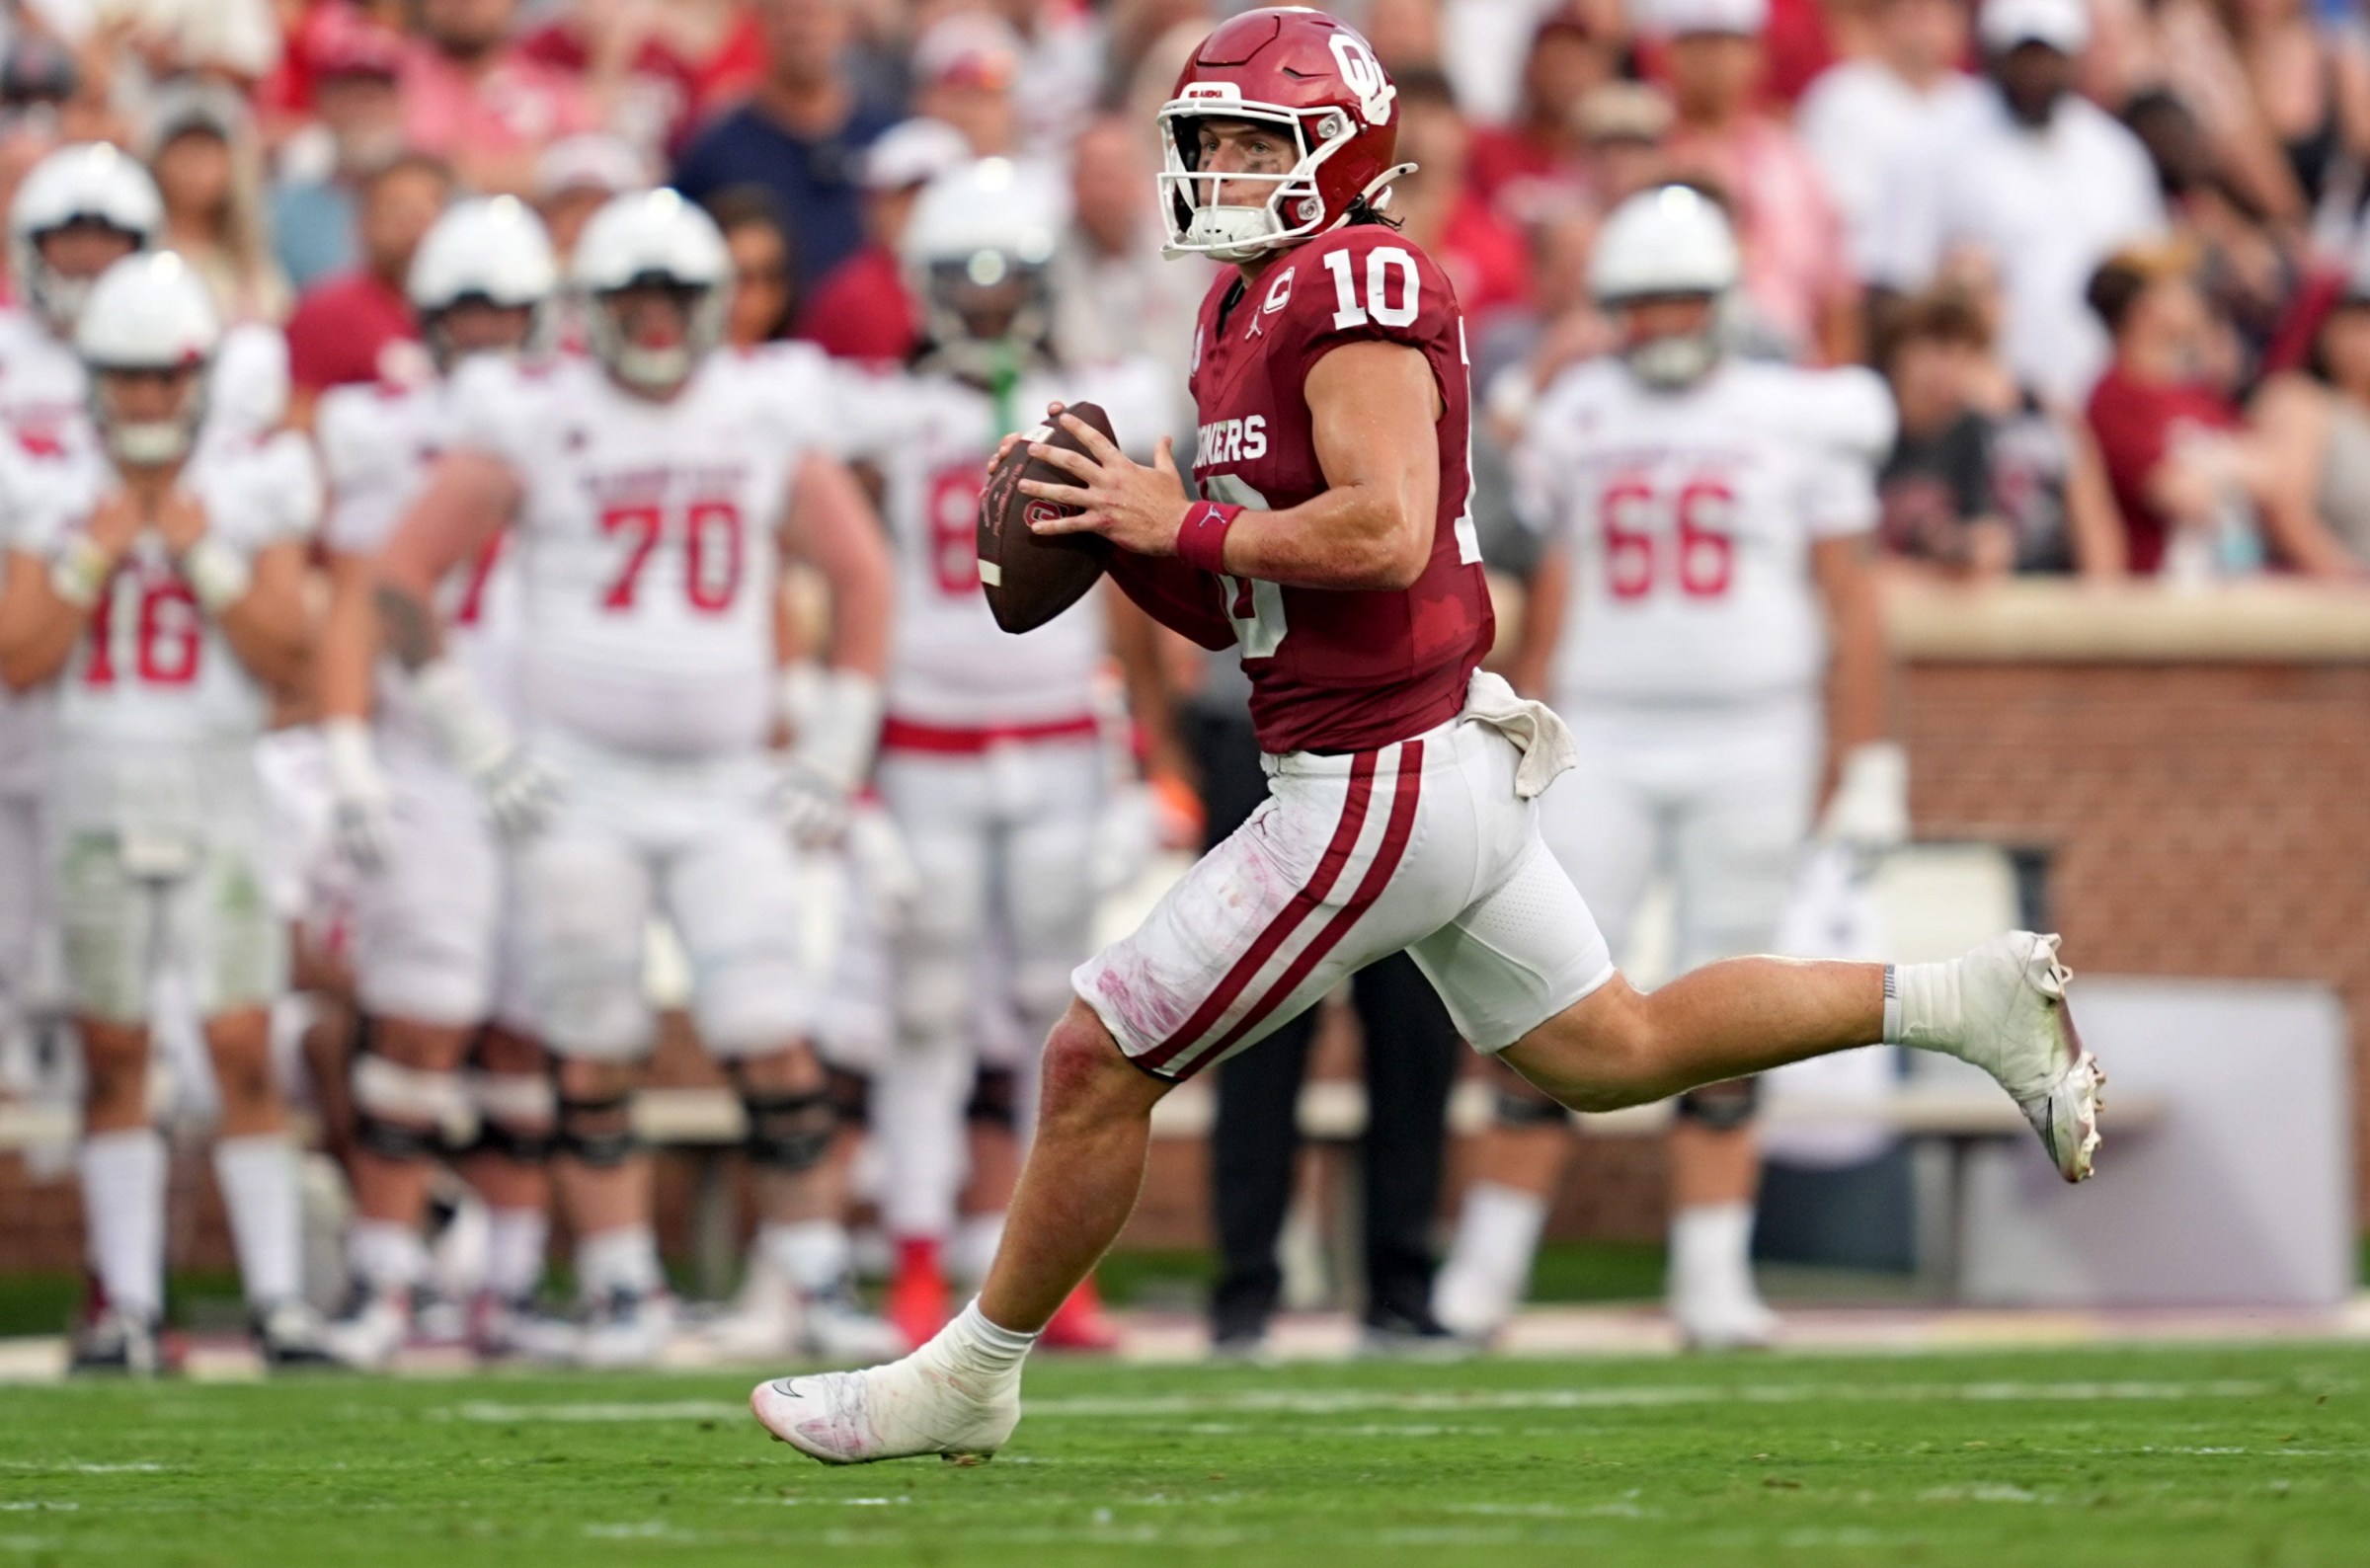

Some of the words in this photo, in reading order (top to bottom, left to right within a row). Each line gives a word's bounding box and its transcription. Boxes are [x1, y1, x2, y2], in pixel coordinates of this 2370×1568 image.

[1263, 266, 1296, 314] C
[1323, 246, 1420, 330] 10
[598, 503, 744, 614] 70
[1600, 480, 1734, 600] 66
[83, 575, 199, 684] 16
